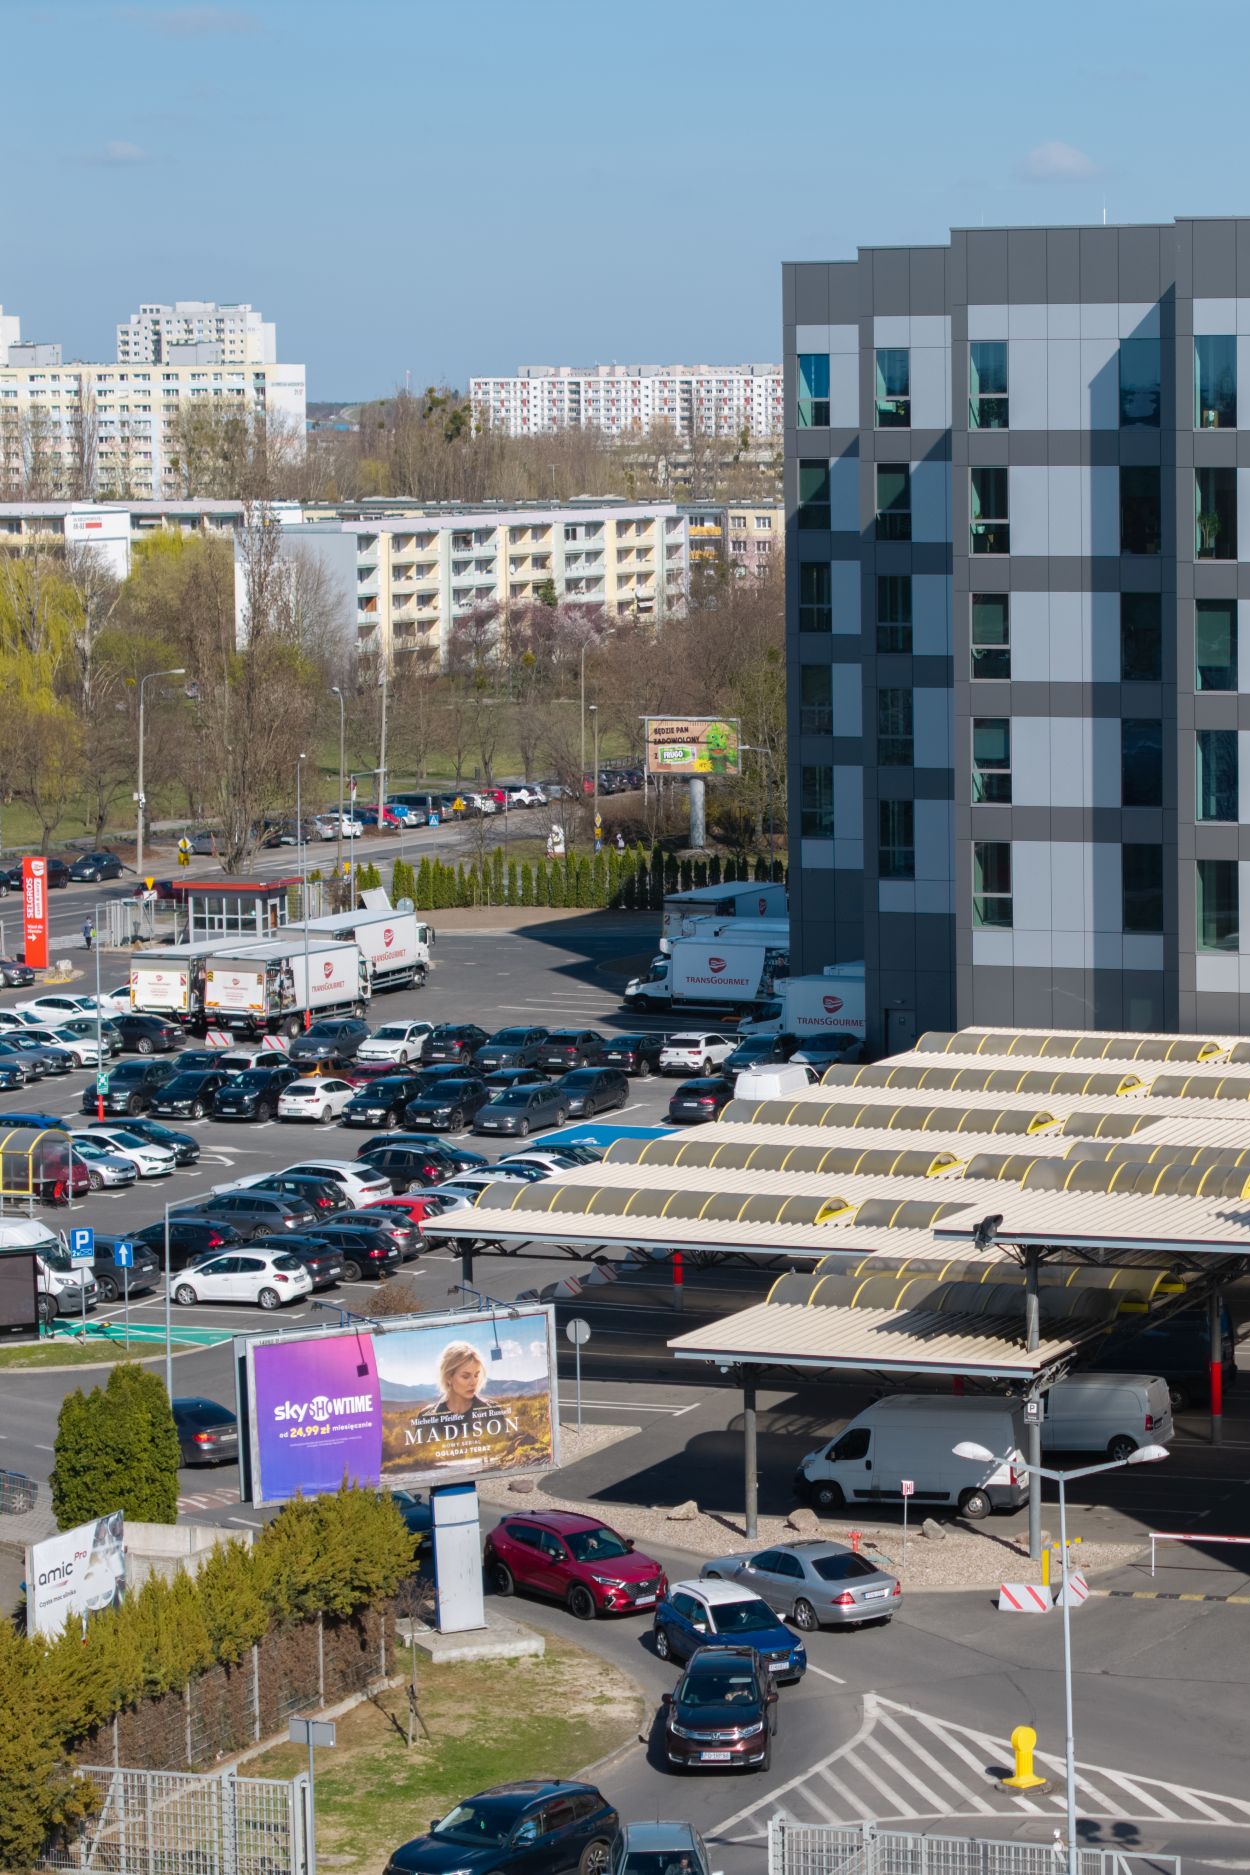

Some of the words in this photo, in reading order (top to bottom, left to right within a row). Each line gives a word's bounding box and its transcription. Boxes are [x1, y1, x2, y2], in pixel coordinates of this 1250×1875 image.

[654, 727, 674, 736] BĘDZIE
[676, 726, 689, 734] PAN
[653, 735, 700, 745] ZADOWOLONY
[663, 750, 683, 759] FRUGO
[26, 877, 34, 919] SELGROS
[686, 976, 749, 986] TRANSGOURMET
[797, 1016, 863, 1027] TRANSGOURME
[75, 1230, 89, 1249] P
[410, 1415, 439, 1426] Michelle
[440, 1413, 465, 1423] Pfeiffer
[472, 1410, 488, 1418] Kurt
[489, 1407, 512, 1417] Russell
[289, 1425, 319, 1438] 24,99
[320, 1424, 331, 1435] zł
[332, 1421, 373, 1432] miesięcznie
[404, 1416, 520, 1446] MADISON
[435, 1447, 468, 1457] OGLĄDAJ
[470, 1445, 491, 1453] TERAZ
[74, 1550, 87, 1560] Pro
[38, 1561, 74, 1586] amic
